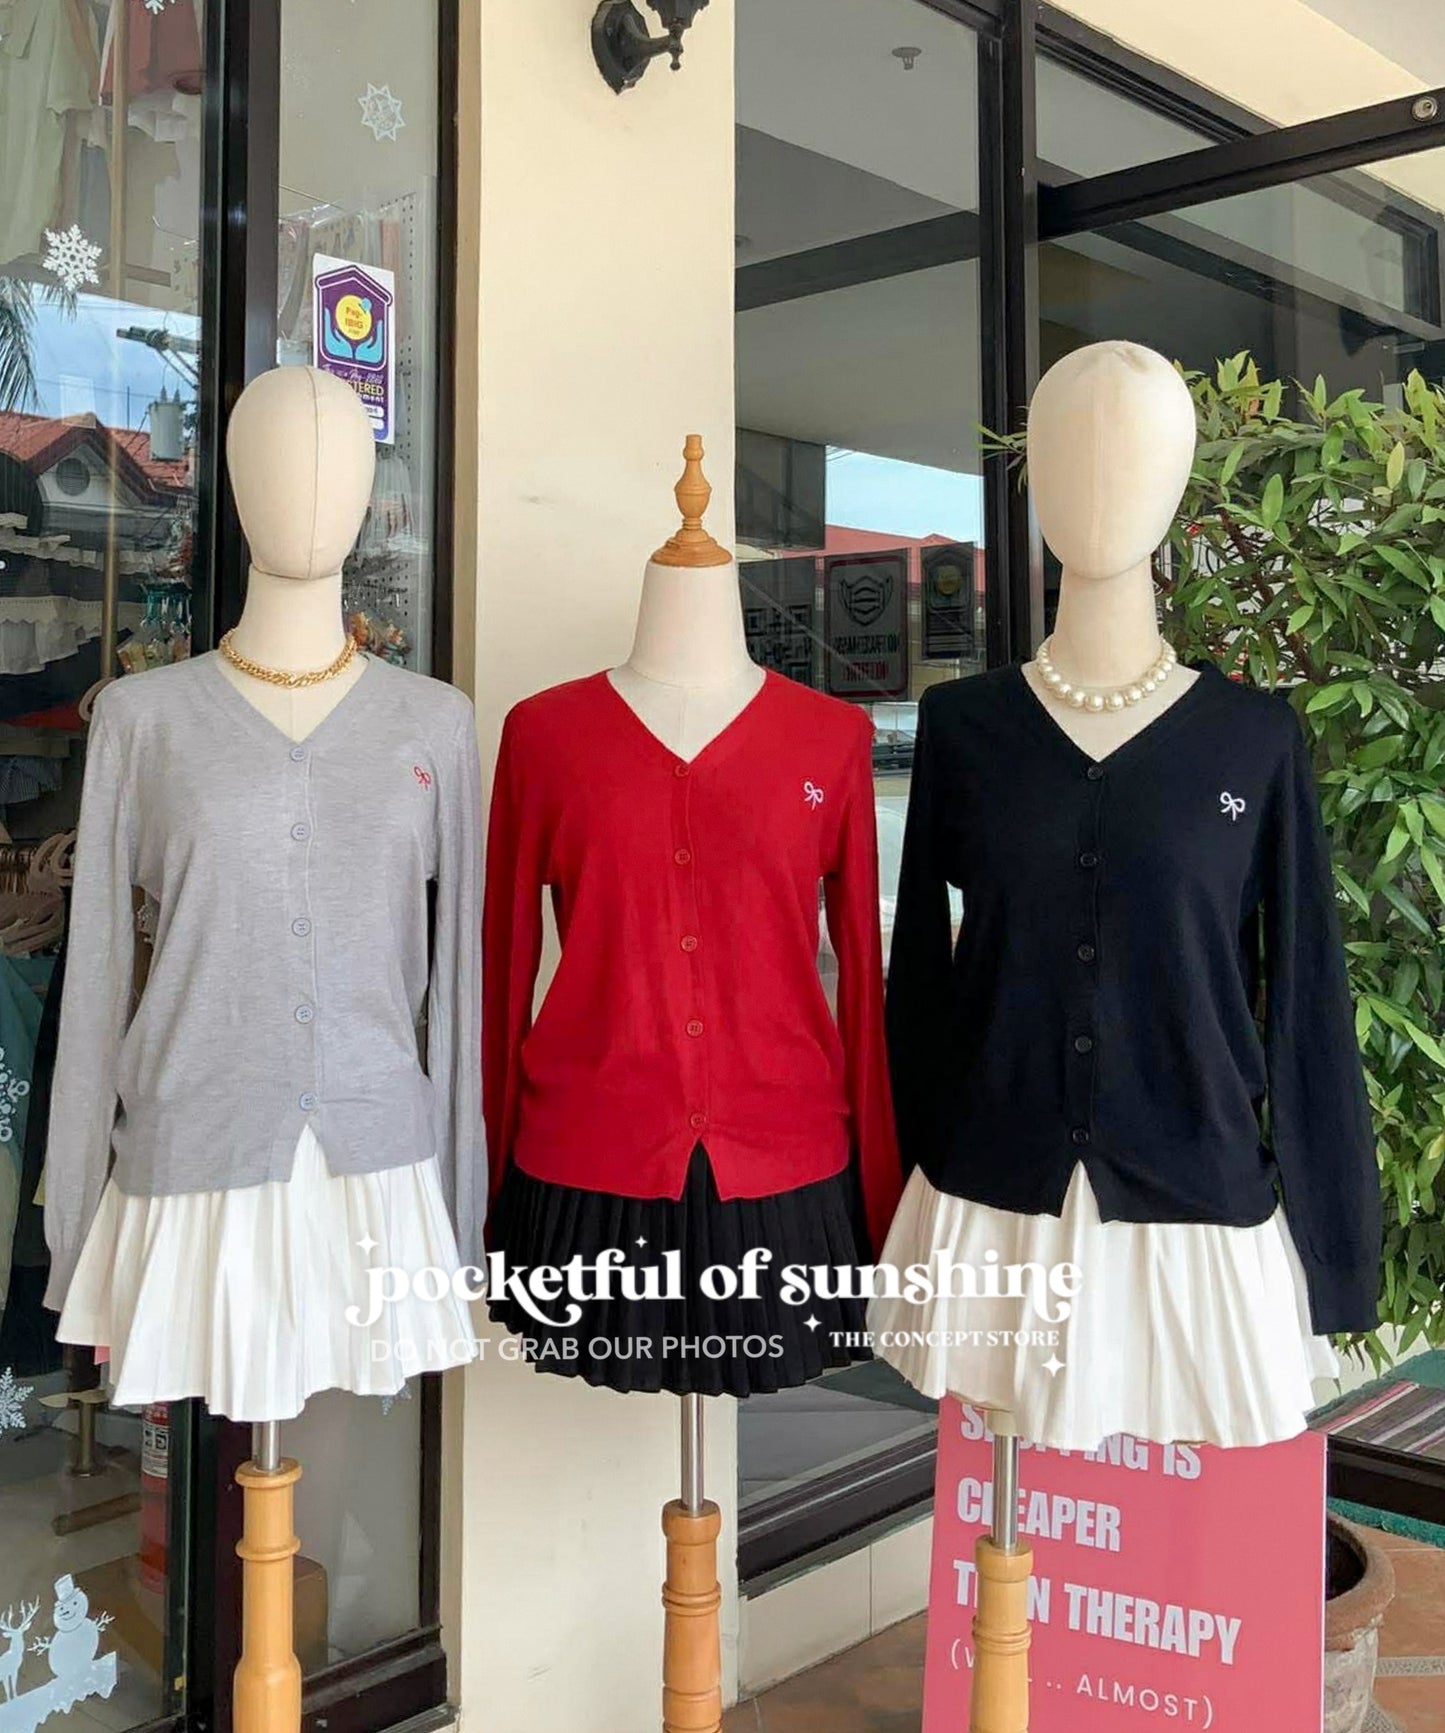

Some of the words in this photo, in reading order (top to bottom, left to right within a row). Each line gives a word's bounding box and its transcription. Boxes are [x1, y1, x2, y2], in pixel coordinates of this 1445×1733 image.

[1163, 1441, 1202, 1480] IS
[953, 1559, 1051, 1625] TN
[1063, 1582, 1242, 1666] THERAPY
[1076, 1673, 1214, 1730] ALMOST)
